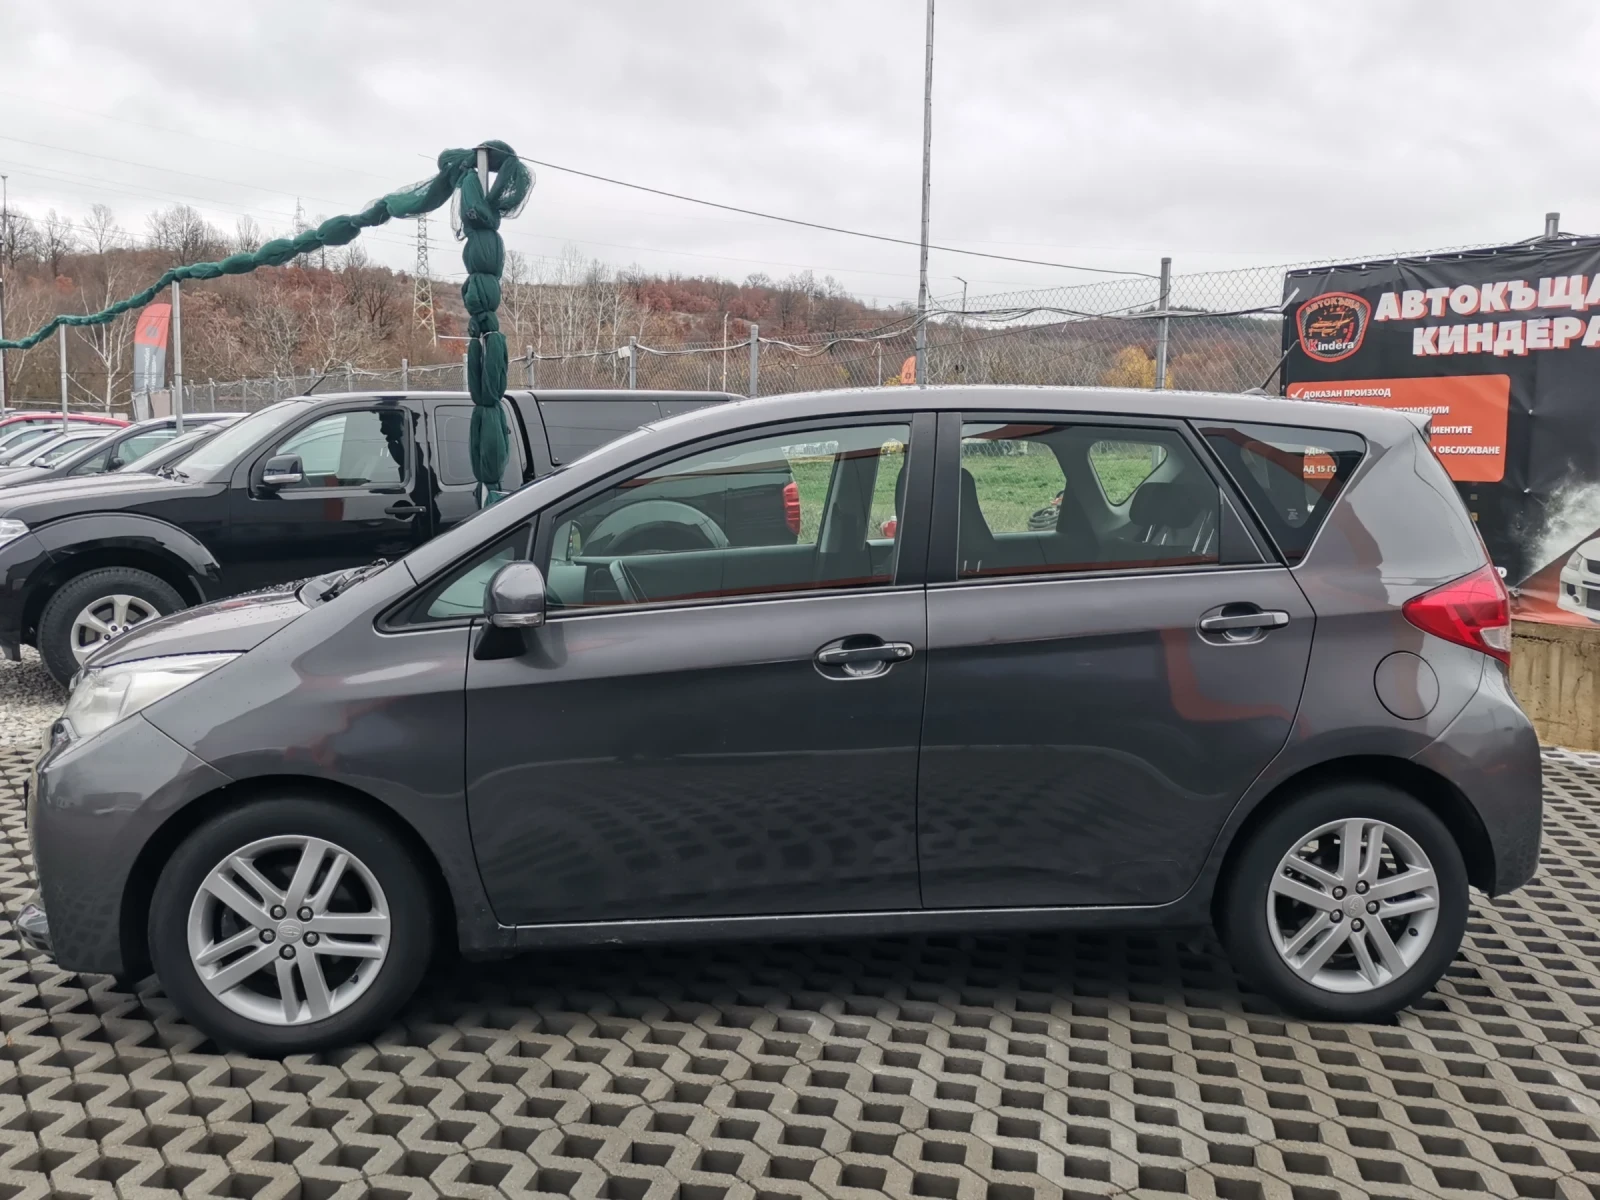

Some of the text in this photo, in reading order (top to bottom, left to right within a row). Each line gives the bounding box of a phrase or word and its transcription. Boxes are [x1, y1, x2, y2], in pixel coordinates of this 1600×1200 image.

[1374, 273, 1600, 322] АВТОКЪЩА
[1412, 315, 1600, 357] КИНДЕРА
[1308, 339, 1354, 351] Kindera
[1303, 388, 1391, 399] ДОКАЗАН ПРОИЗХОД
[1430, 426, 1473, 434] ИЕНТИТЕ
[1438, 446, 1500, 454] ОБСЛУЖВАНЕ
[1316, 465, 1325, 473] 15
